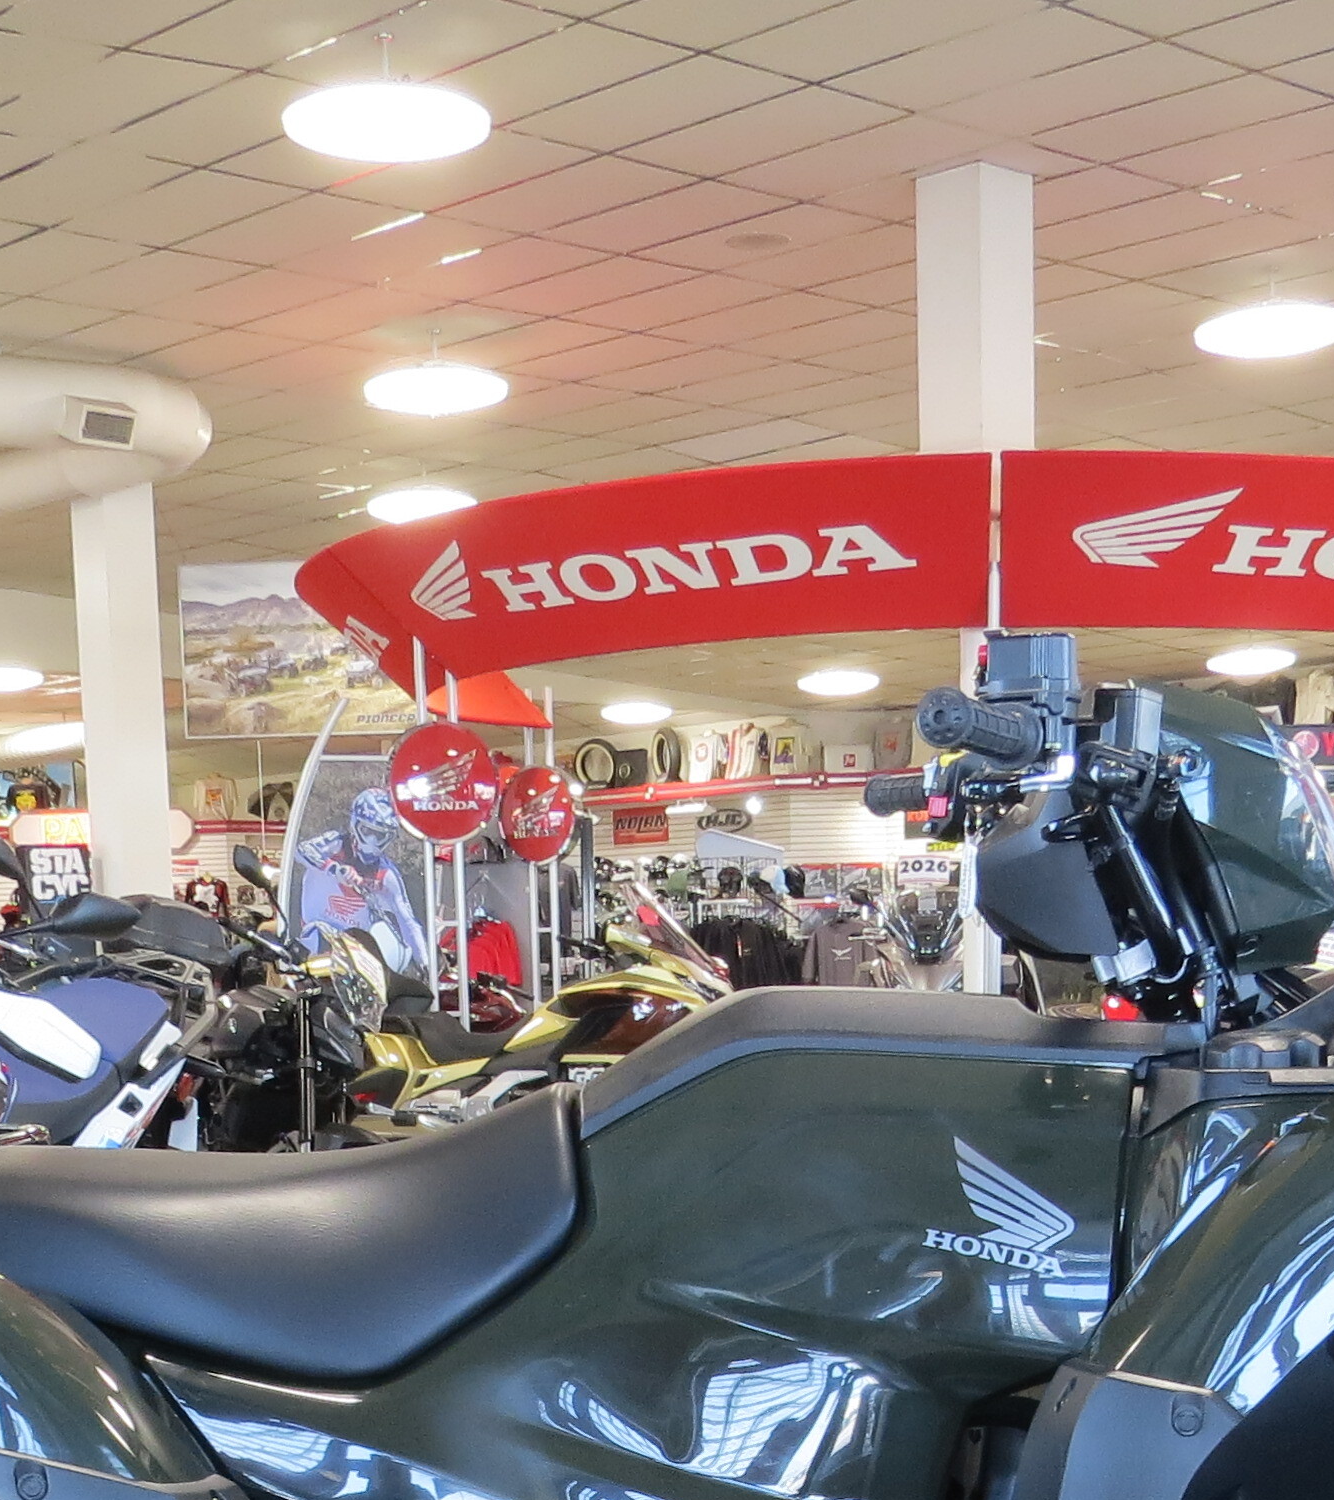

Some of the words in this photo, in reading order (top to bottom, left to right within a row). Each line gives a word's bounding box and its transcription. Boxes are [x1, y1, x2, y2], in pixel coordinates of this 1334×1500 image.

[480, 523, 917, 614] HONDA
[412, 799, 479, 812] HONDA
[616, 812, 667, 834] NOLAN
[899, 859, 948, 874] 2026
[921, 1228, 1066, 1279] HONDA
